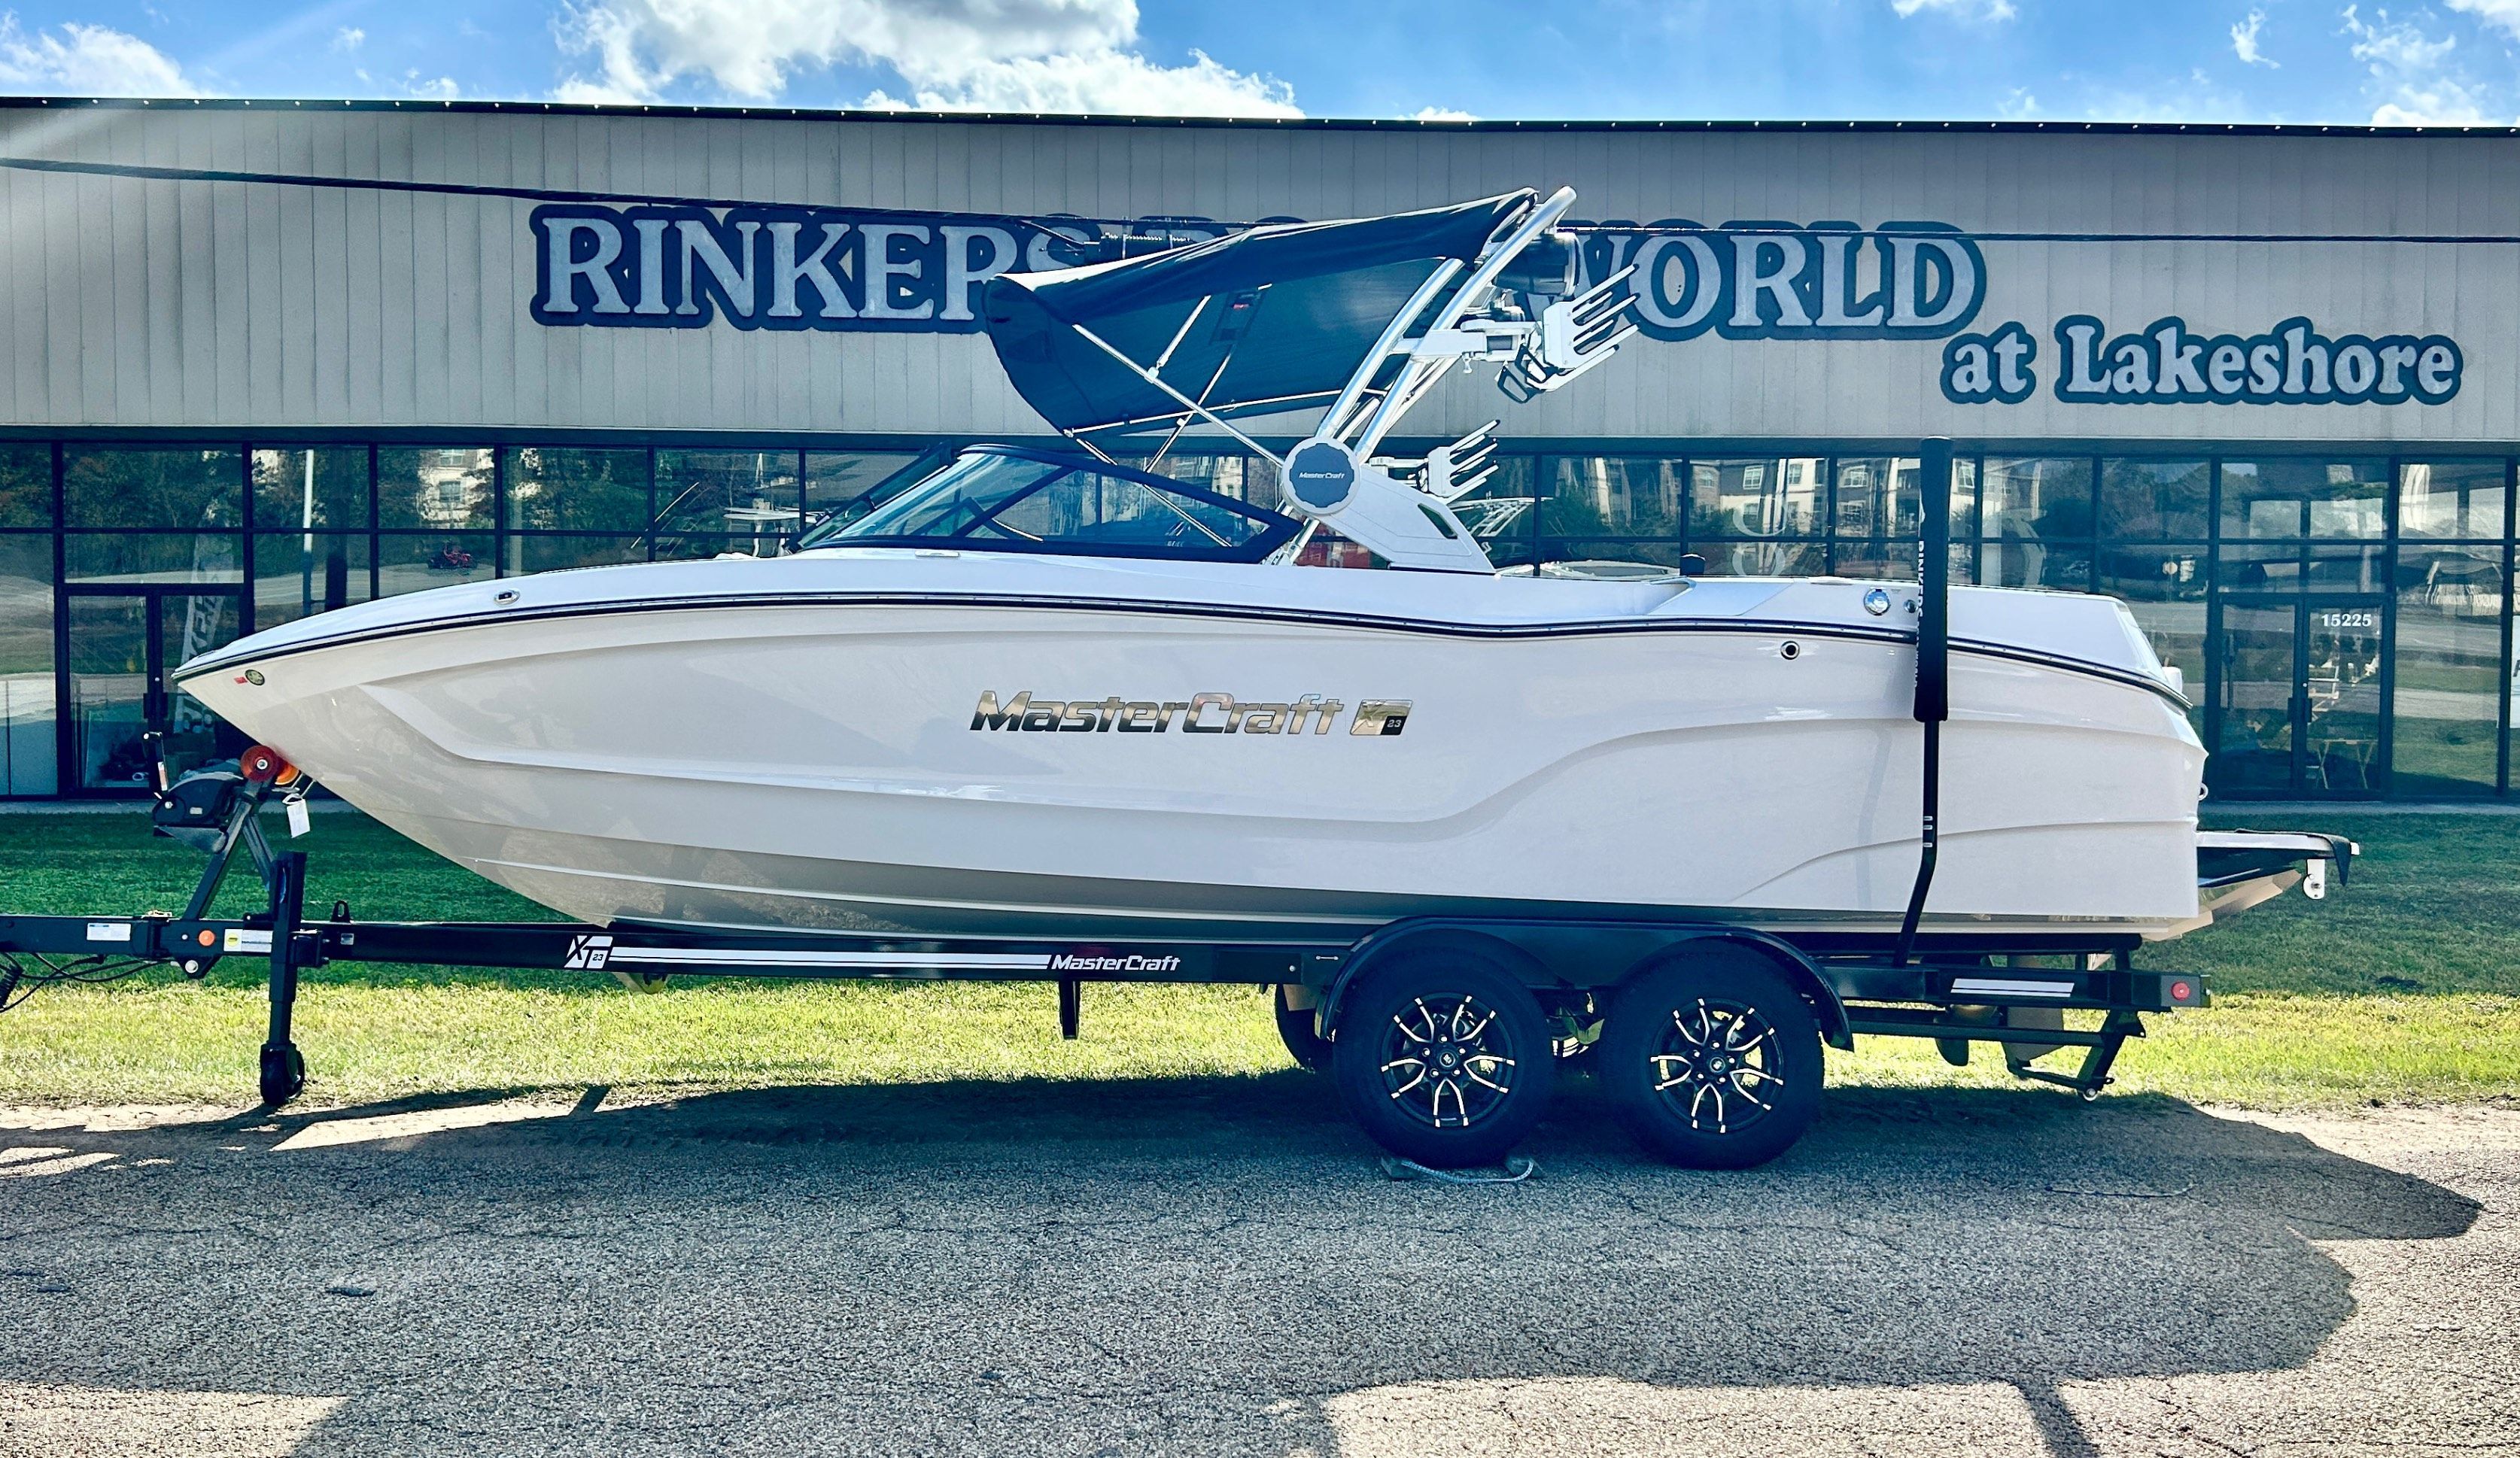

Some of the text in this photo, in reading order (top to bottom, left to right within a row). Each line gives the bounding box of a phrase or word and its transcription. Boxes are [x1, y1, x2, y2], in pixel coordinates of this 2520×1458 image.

[1951, 323, 2456, 396] at Lakeshore
[2321, 613, 2372, 627] 15225
[969, 690, 1345, 735] MasterCraft
[1387, 719, 1402, 727] 23
[564, 935, 613, 968] XT 23
[1051, 954, 1181, 971] MasterCraft
